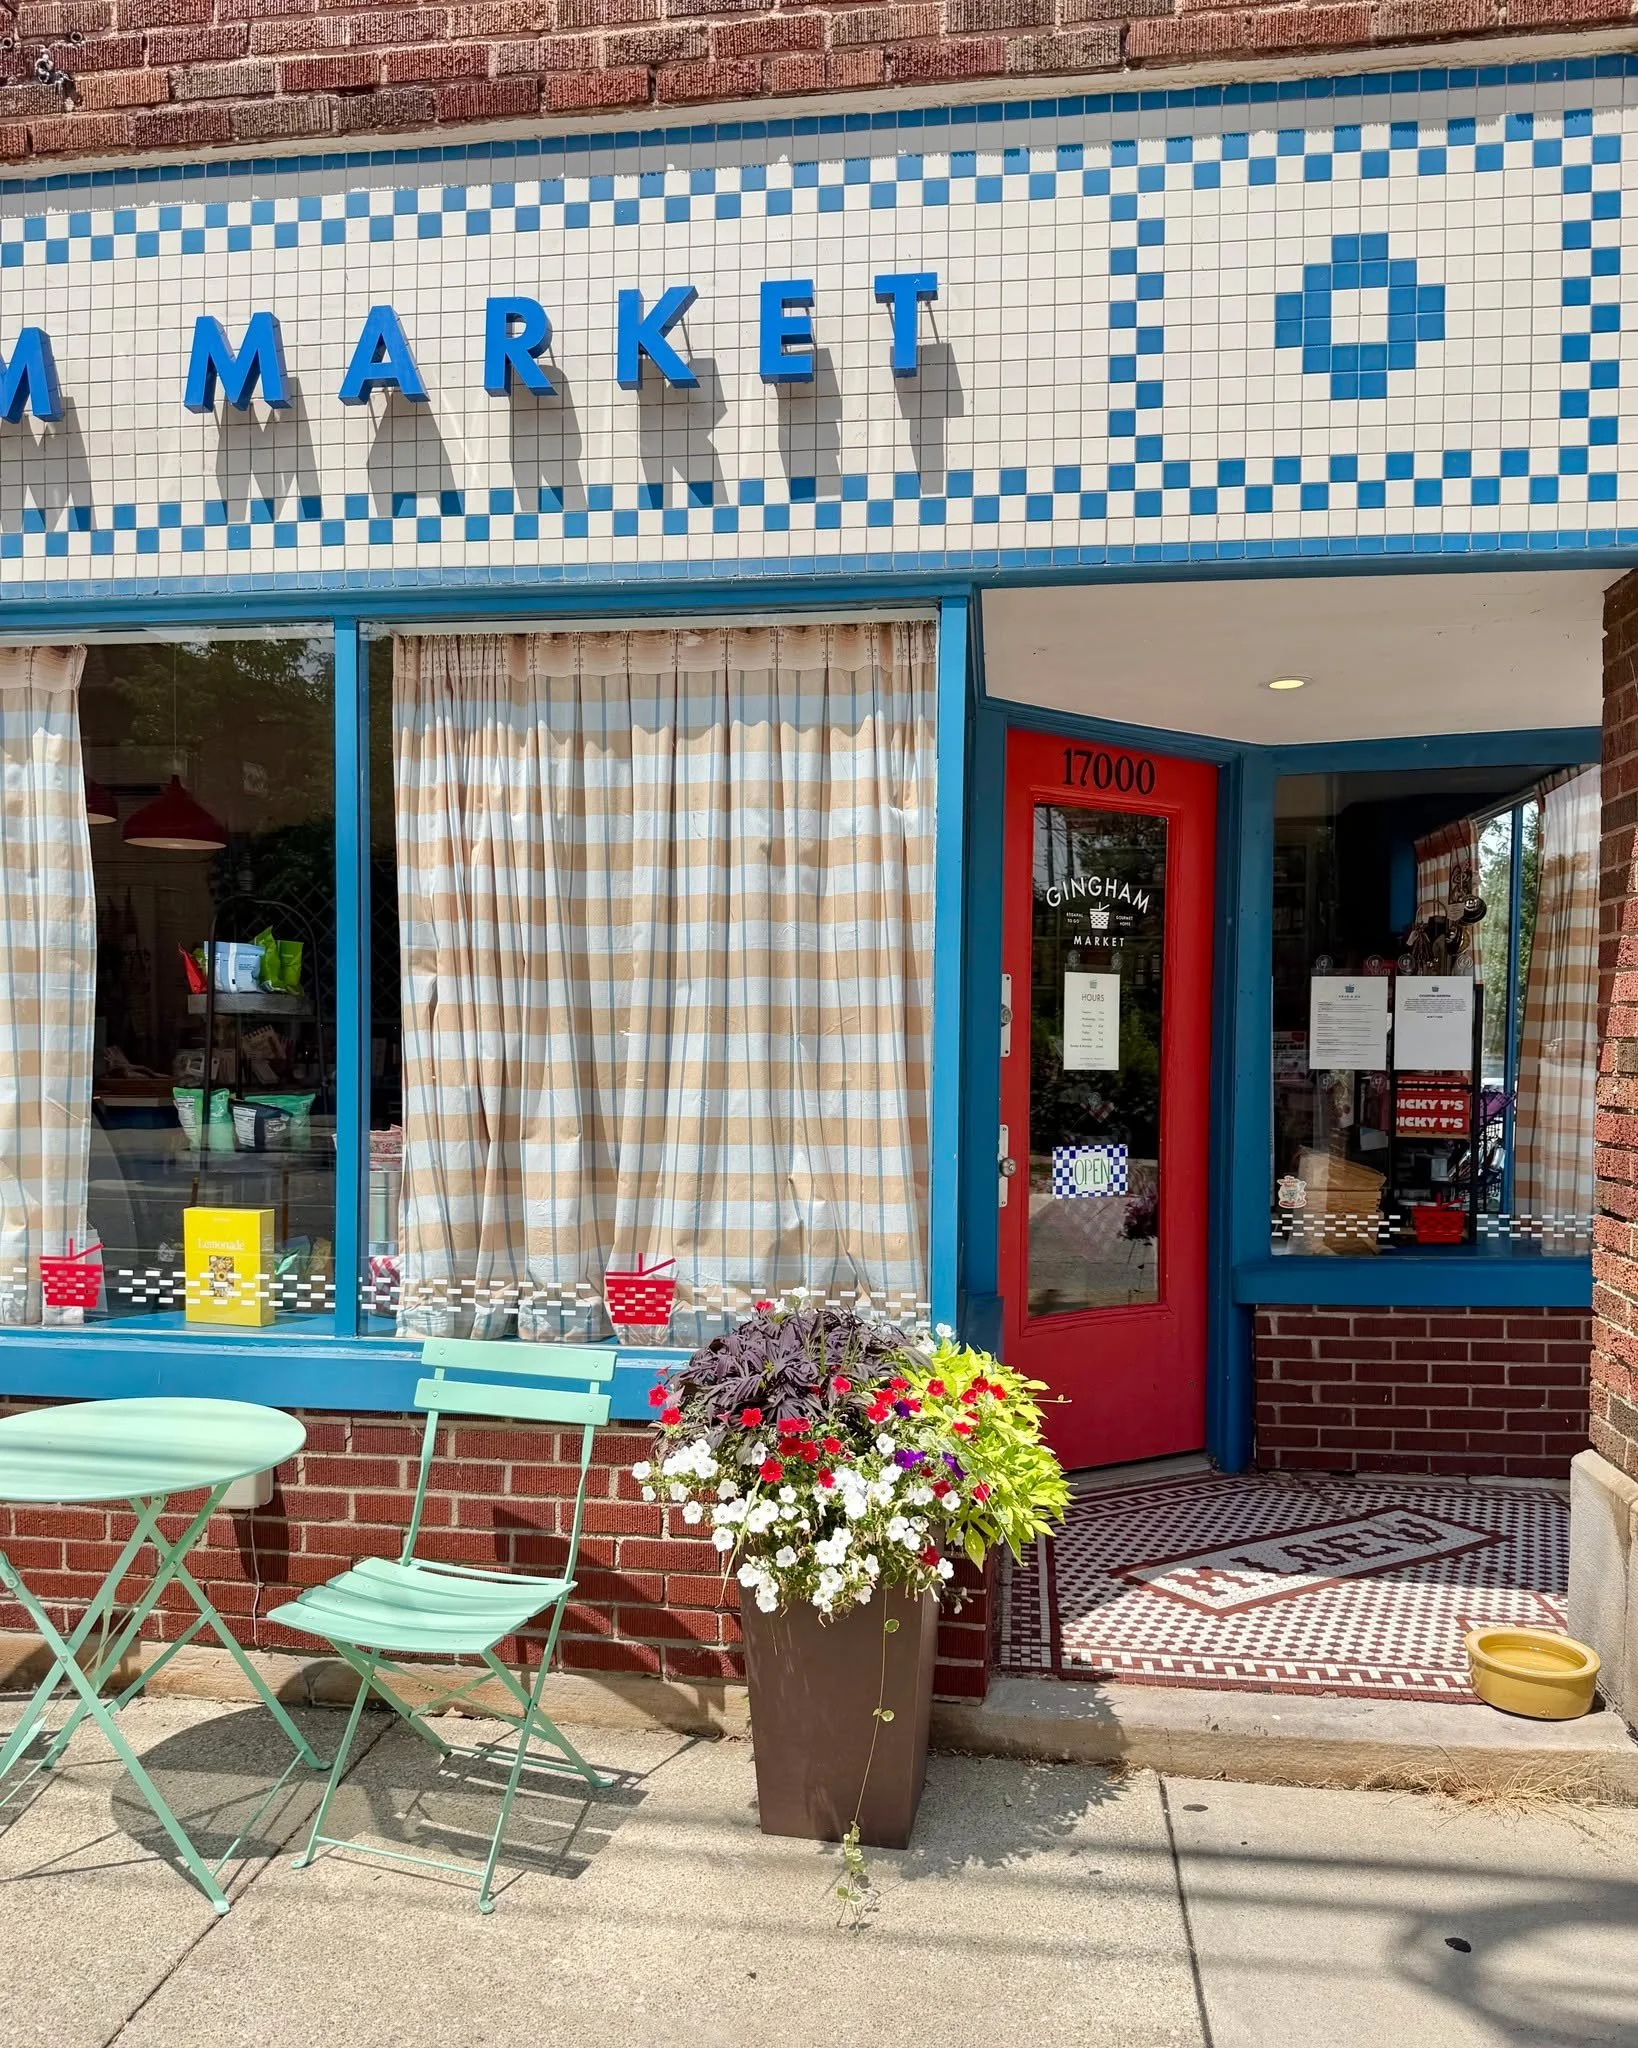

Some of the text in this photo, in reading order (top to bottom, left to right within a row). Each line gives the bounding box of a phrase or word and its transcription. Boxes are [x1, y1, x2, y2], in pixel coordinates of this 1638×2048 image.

[184, 272, 938, 414] MARKET
[1062, 748, 1155, 795] 17000
[1046, 875, 1150, 914] GINGHAM
[1073, 935, 1125, 947] MARKET
[1081, 993, 1105, 1002] HOURS
[1440, 1099, 1464, 1111] T'S
[1439, 1117, 1463, 1129] T'S
[1074, 1158, 1110, 1186] OPEN
[197, 1237, 245, 1251] Lemonade
[1230, 1518, 1444, 1576] LOEW
